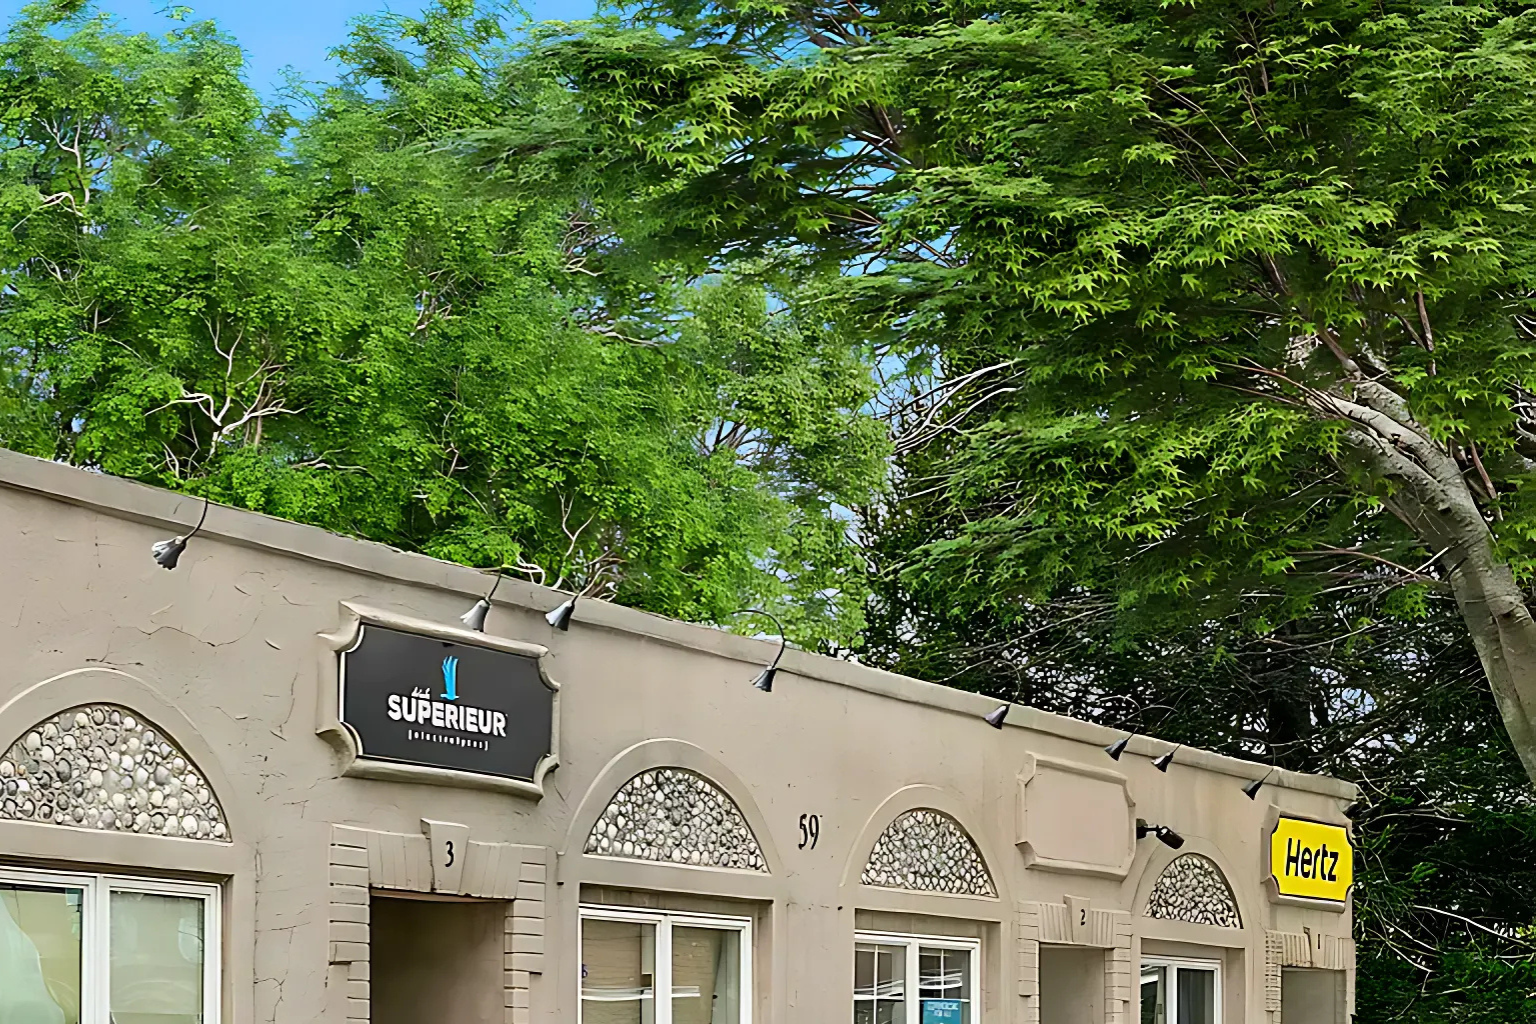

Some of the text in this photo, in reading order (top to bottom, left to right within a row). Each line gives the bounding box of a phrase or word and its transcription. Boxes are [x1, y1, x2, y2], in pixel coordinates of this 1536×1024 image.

[387, 694, 506, 737] SUPERIEUR
[798, 813, 819, 850] 59
[444, 840, 454, 868] 3
[1285, 836, 1339, 882] Hertz
[1080, 908, 1086, 926] 2
